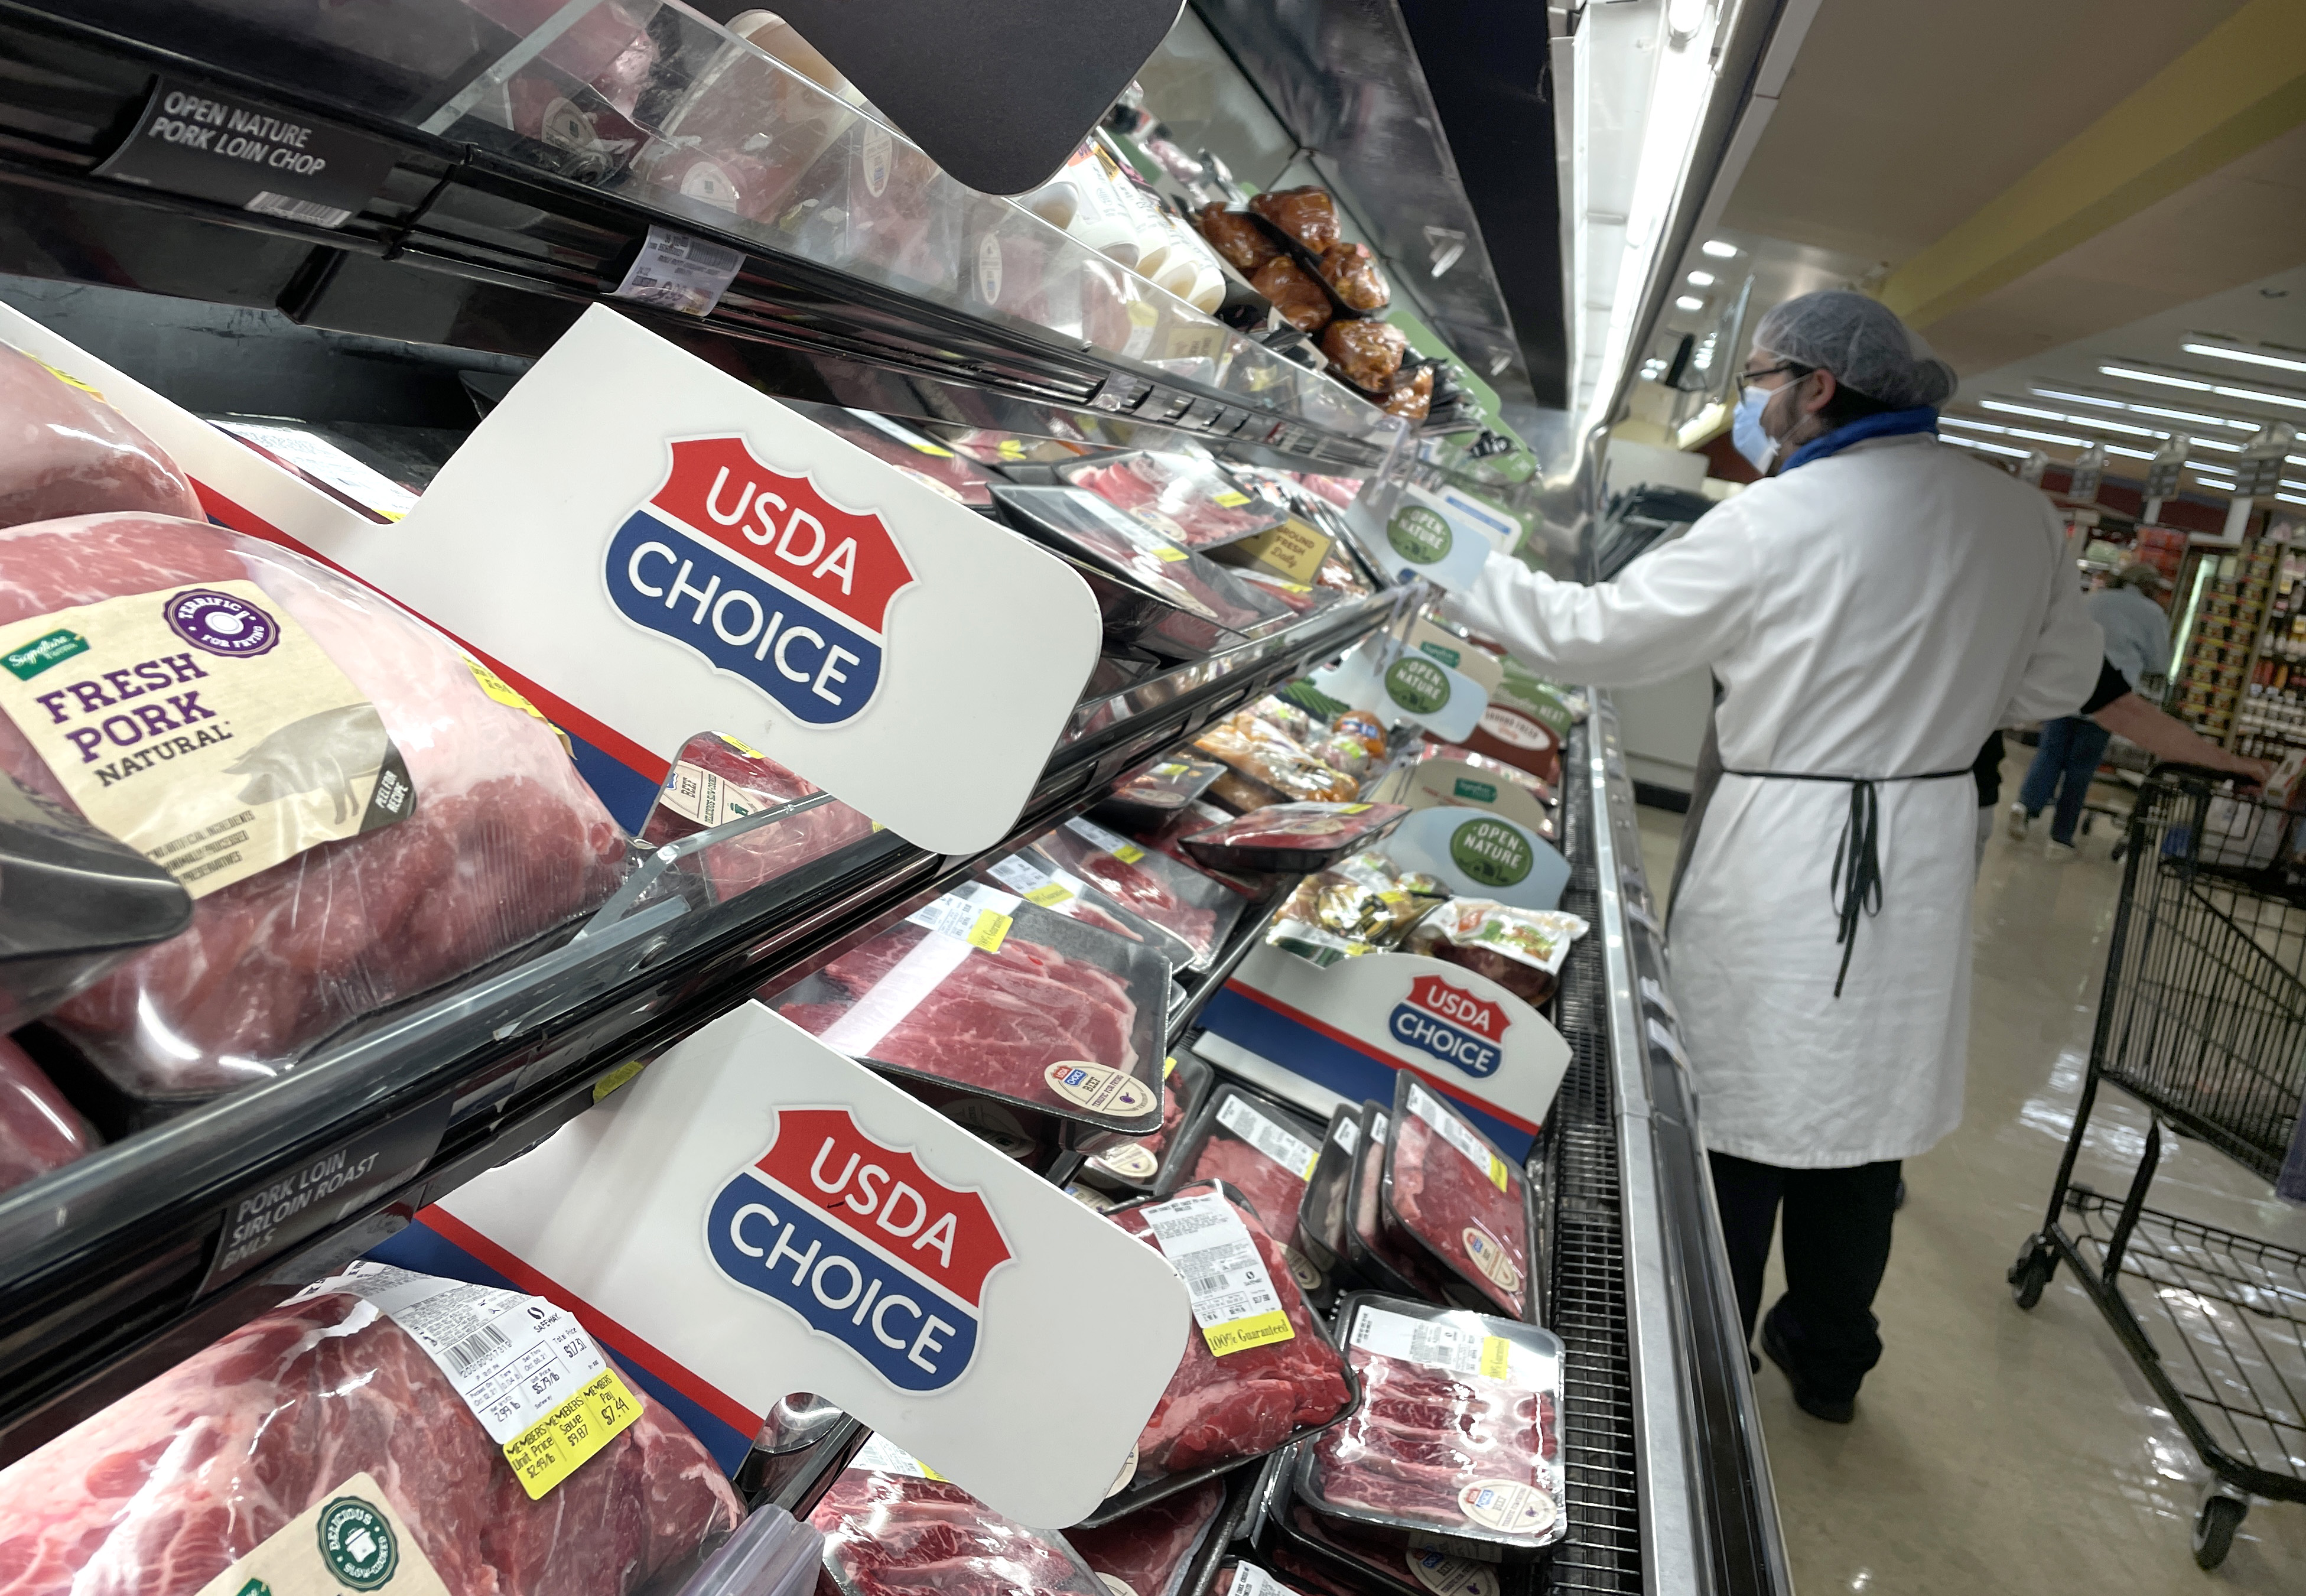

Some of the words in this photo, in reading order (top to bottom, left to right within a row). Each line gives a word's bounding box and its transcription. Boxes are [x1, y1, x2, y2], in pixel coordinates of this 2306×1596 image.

[164, 91, 229, 126] OPEN
[227, 109, 312, 148] NATURE
[148, 117, 216, 150] PORK
[214, 134, 269, 162] LOIN
[268, 148, 326, 175] CHOP
[705, 466, 857, 596] USDA
[1398, 518, 1443, 550] NATURE
[1410, 509, 1443, 535] OPEN
[178, 597, 242, 619] TERRIFIC
[628, 541, 860, 706] CHOICE
[201, 634, 230, 647] FOR
[233, 626, 265, 648] FRYING
[35, 652, 210, 725] FRESH
[1396, 669, 1442, 700] NATURE
[1409, 661, 1442, 685] OPEN
[65, 690, 218, 764] PORK
[93, 724, 234, 787] NATURAL
[381, 770, 398, 790] FOR
[681, 777, 697, 799] BEEF
[375, 788, 391, 808] PEEL
[386, 786, 405, 814] RECIPE
[1463, 834, 1522, 869] NATURE
[1478, 823, 1520, 851] OPEN
[1427, 984, 1490, 1032] USDA
[1396, 1013, 1494, 1072] CHOICE
[1082, 1077, 1101, 1092] BEEF
[230, 1189, 313, 1248] SIRLOIN
[314, 1152, 379, 1201] ROAST
[237, 1176, 295, 1223] PORK
[298, 1150, 347, 1189] LOIN
[810, 1136, 957, 1269] USDA
[222, 1228, 277, 1270] BNLS
[730, 1203, 956, 1374] CHOICE
[533, 1312, 562, 1333] SAFEWAY
[1208, 1332, 1237, 1351] 100%
[1237, 1319, 1289, 1343] Guaranteed
[583, 1374, 613, 1398] MEMBERS
[600, 1391, 616, 1404] Pay
[545, 1396, 584, 1427] MEMBERS
[560, 1413, 584, 1435] Save
[601, 1397, 630, 1426] $7.44
[507, 1423, 548, 1455] MEMBERS
[567, 1423, 588, 1447] $9.87
[512, 1452, 532, 1471] Unit
[531, 1436, 554, 1457] Price
[327, 1507, 373, 1551] DELICIOUS
